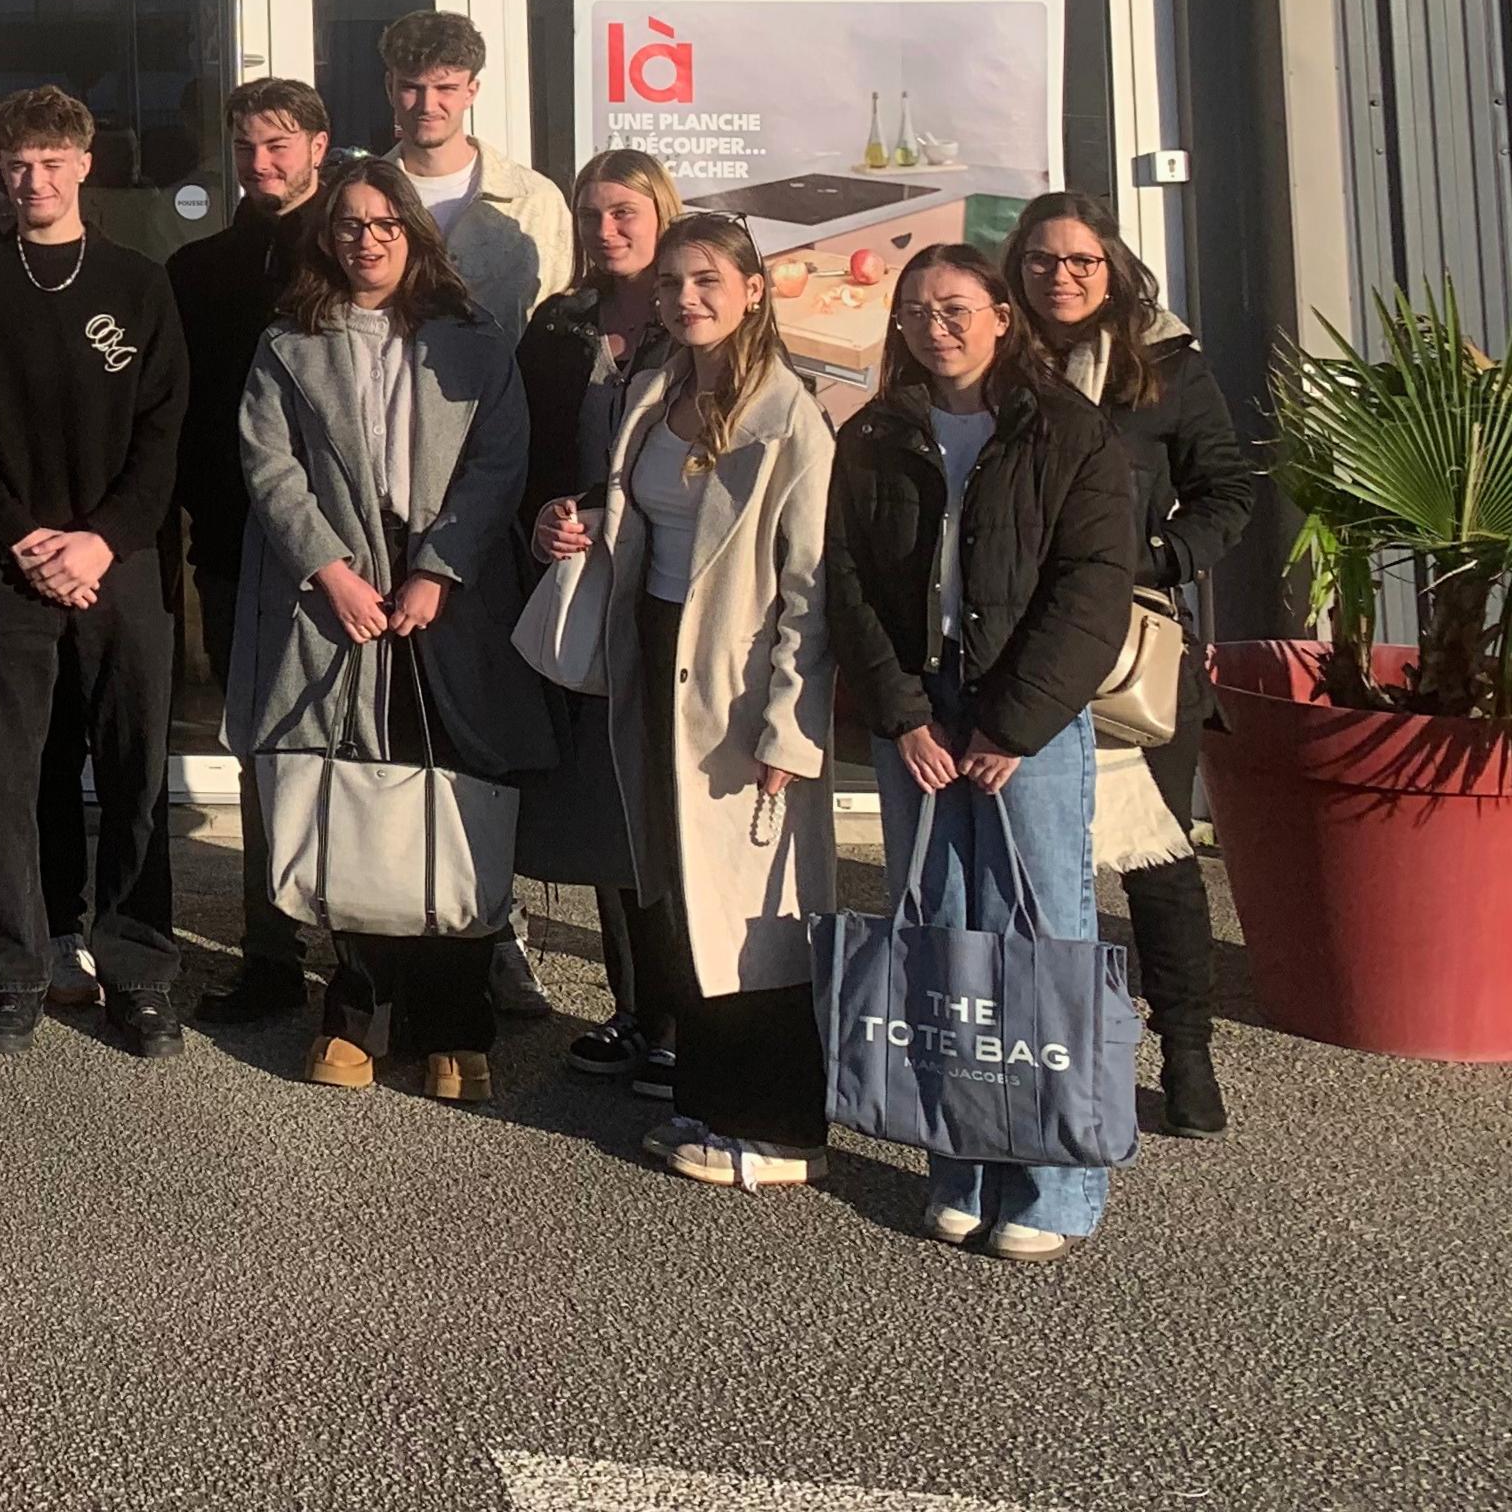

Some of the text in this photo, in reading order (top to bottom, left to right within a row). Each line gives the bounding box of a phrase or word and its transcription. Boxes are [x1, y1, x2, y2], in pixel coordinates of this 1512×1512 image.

[608, 16, 693, 103] là
[608, 113, 761, 131] UNE PLANCHE
[609, 131, 625, 151] À
[663, 160, 749, 178] CACHER
[926, 991, 997, 1025] THE
[859, 1015, 1071, 1071] TOTE BAG
[948, 1067, 1021, 1086] JACOBS
